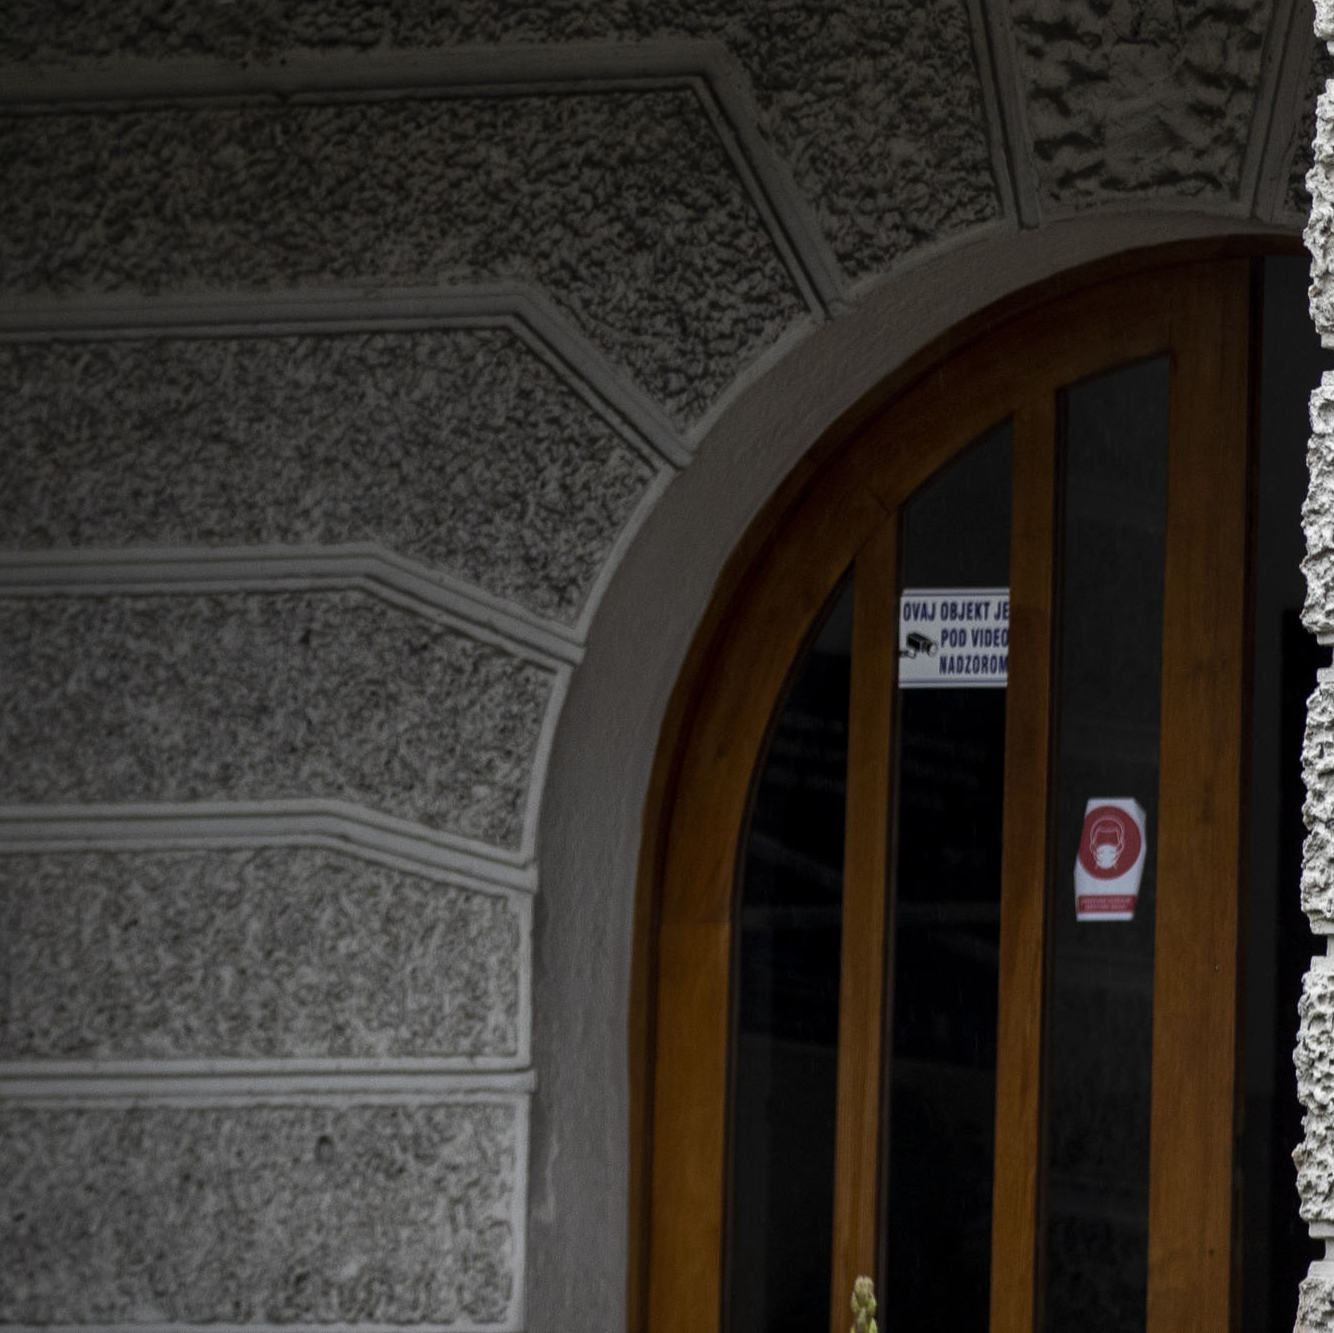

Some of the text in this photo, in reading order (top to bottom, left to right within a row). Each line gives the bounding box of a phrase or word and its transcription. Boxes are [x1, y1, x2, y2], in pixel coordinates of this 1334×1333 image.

[903, 601, 1009, 621] OVAJ OBJEKT JE
[940, 628, 1009, 648] POD VIDEO
